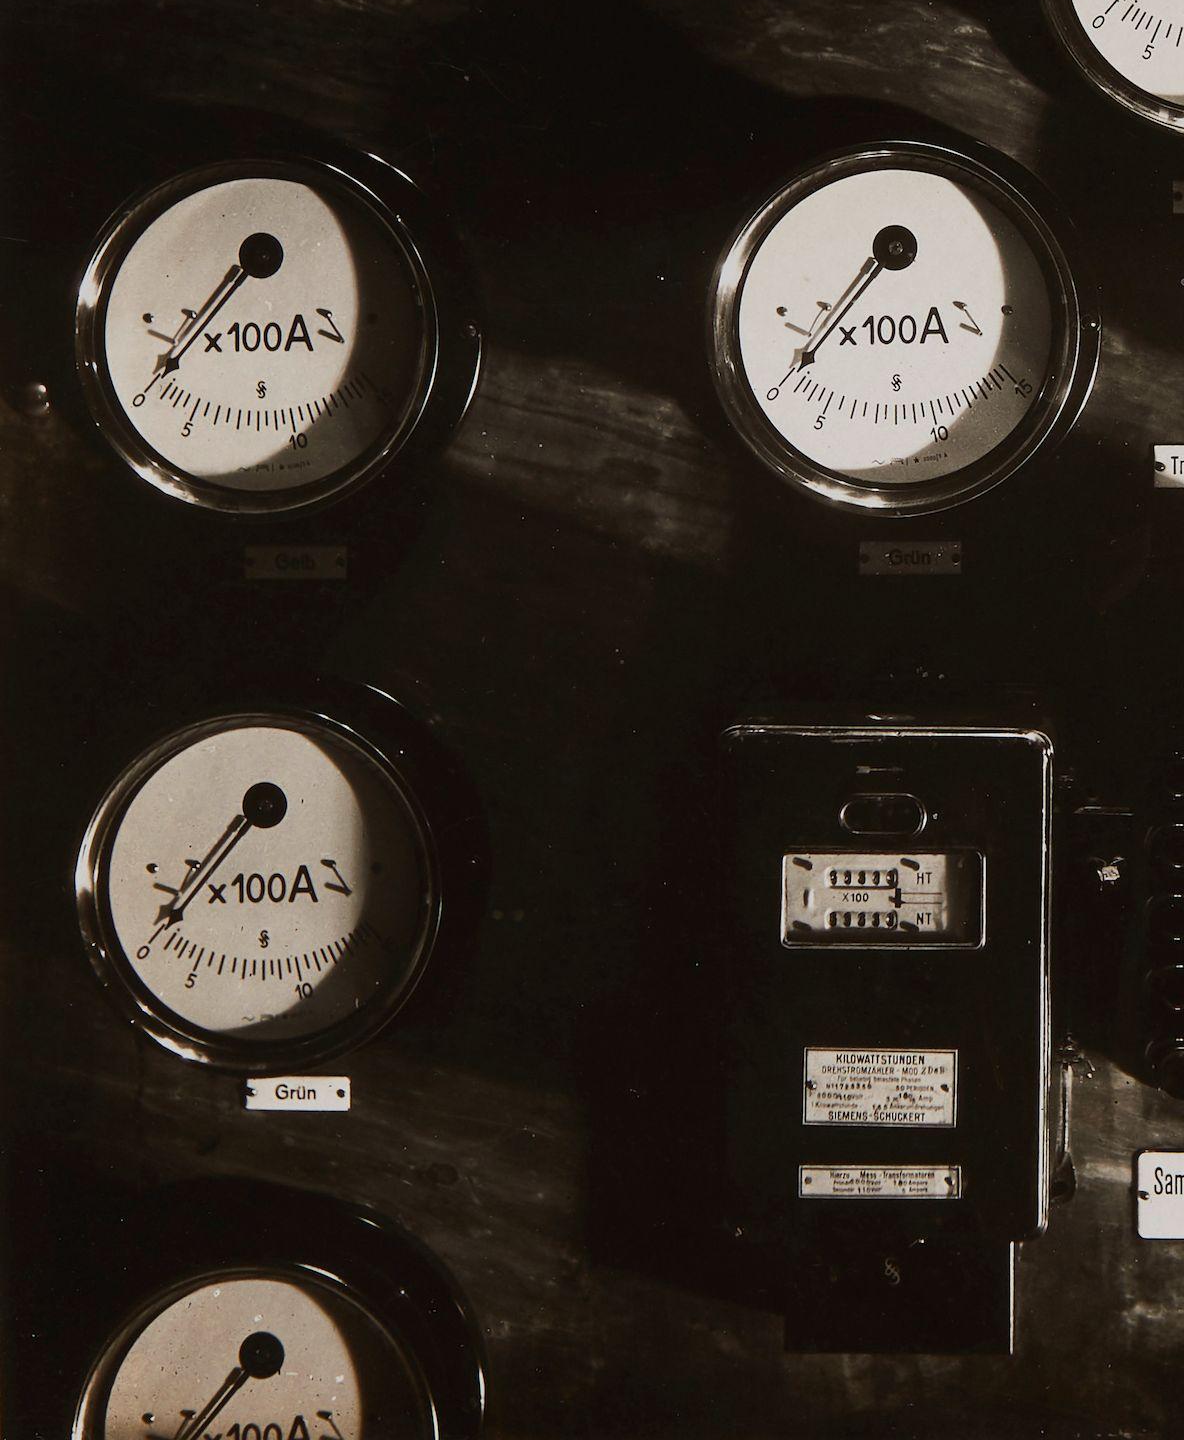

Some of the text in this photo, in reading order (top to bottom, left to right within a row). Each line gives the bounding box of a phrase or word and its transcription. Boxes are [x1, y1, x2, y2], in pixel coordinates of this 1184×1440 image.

[1092, 15, 1105, 29] 0
[1142, 45, 1155, 59] 5
[132, 393, 308, 450] 0 5 10
[766, 378, 1034, 443] 0 5 10 15
[916, 871, 933, 885] HT
[916, 912, 932, 926] NT
[136, 945, 313, 1000] 0 5 10
[836, 1053, 925, 1065] KILOWATTSTUNDEN
[275, 1084, 316, 1100] Grün
[204, 1415, 313, 1440] 100A
